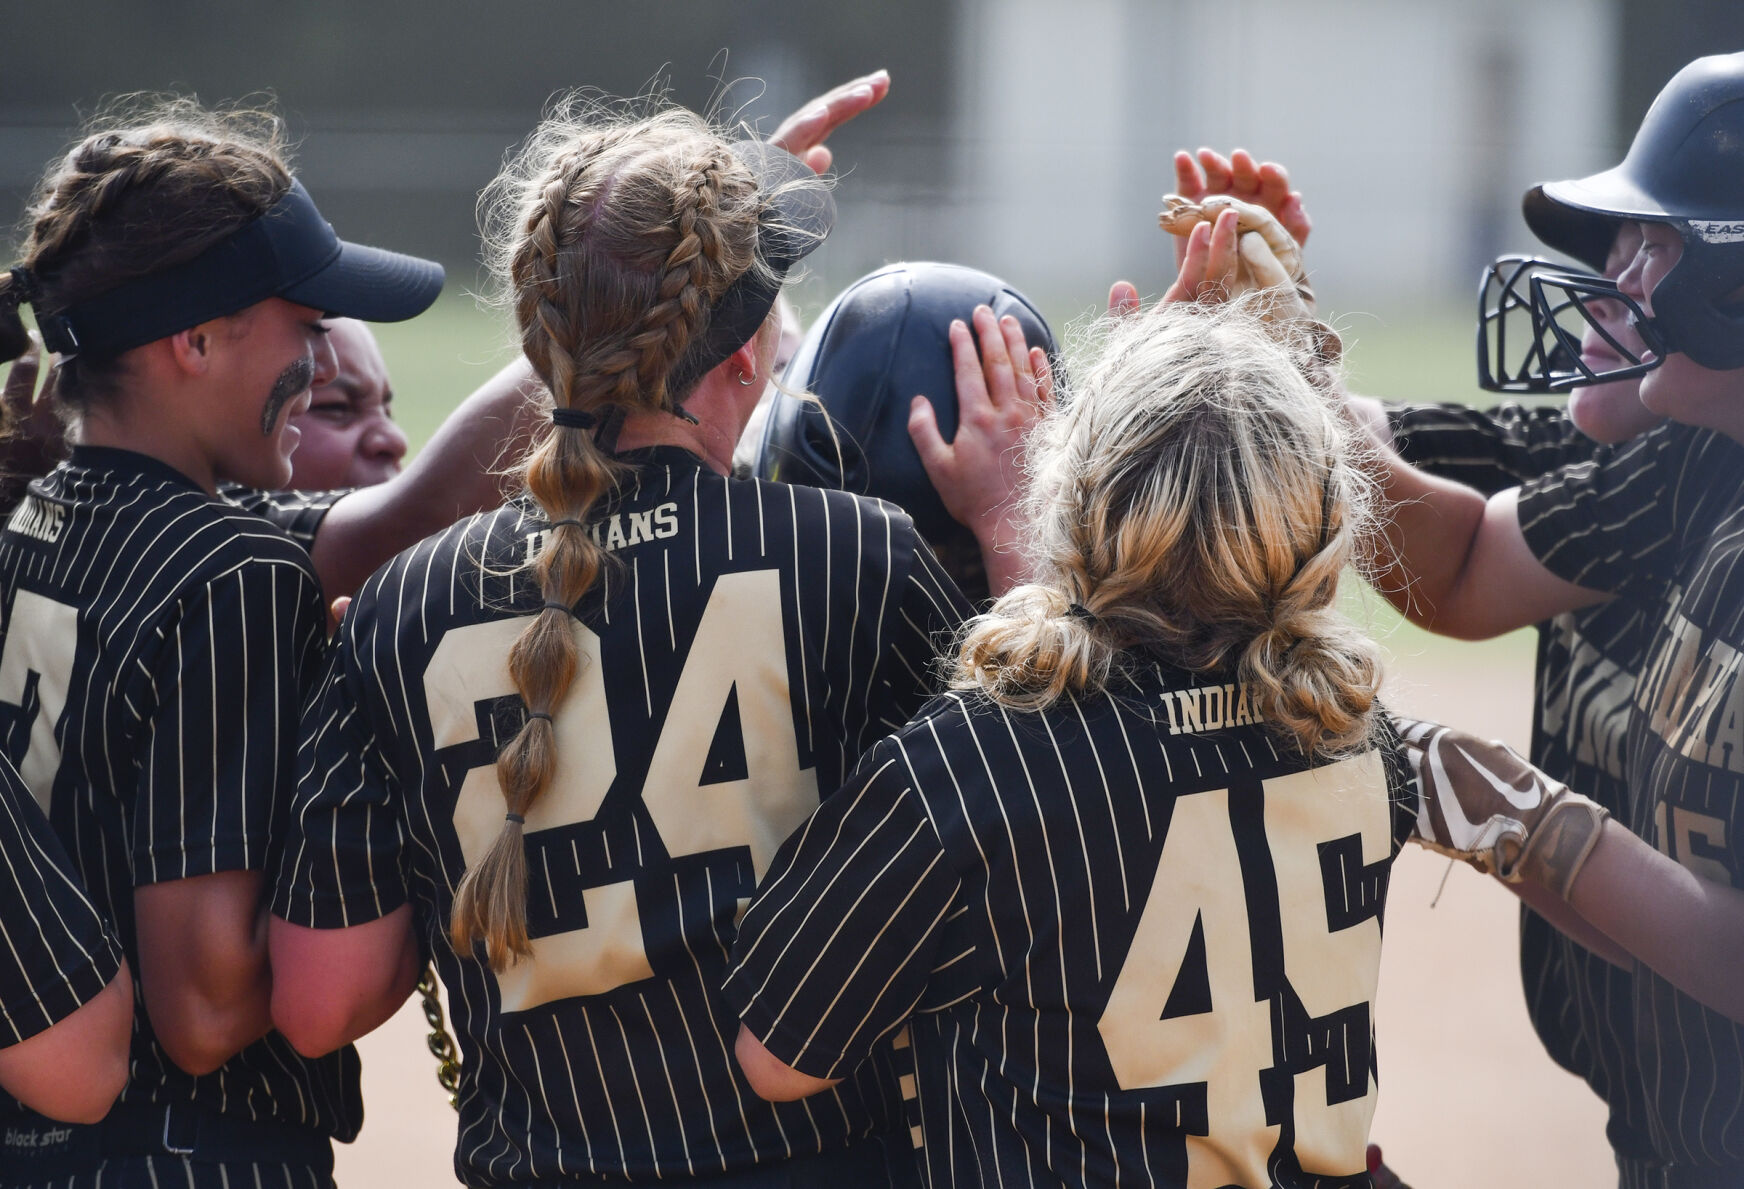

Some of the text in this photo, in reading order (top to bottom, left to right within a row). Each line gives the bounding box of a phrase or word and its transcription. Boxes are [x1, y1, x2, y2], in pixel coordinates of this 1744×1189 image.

[524, 502, 679, 566] IIANS
[423, 568, 821, 1015] 24
[1096, 747, 1378, 1189] 45
[40, 1126, 72, 1146] star
